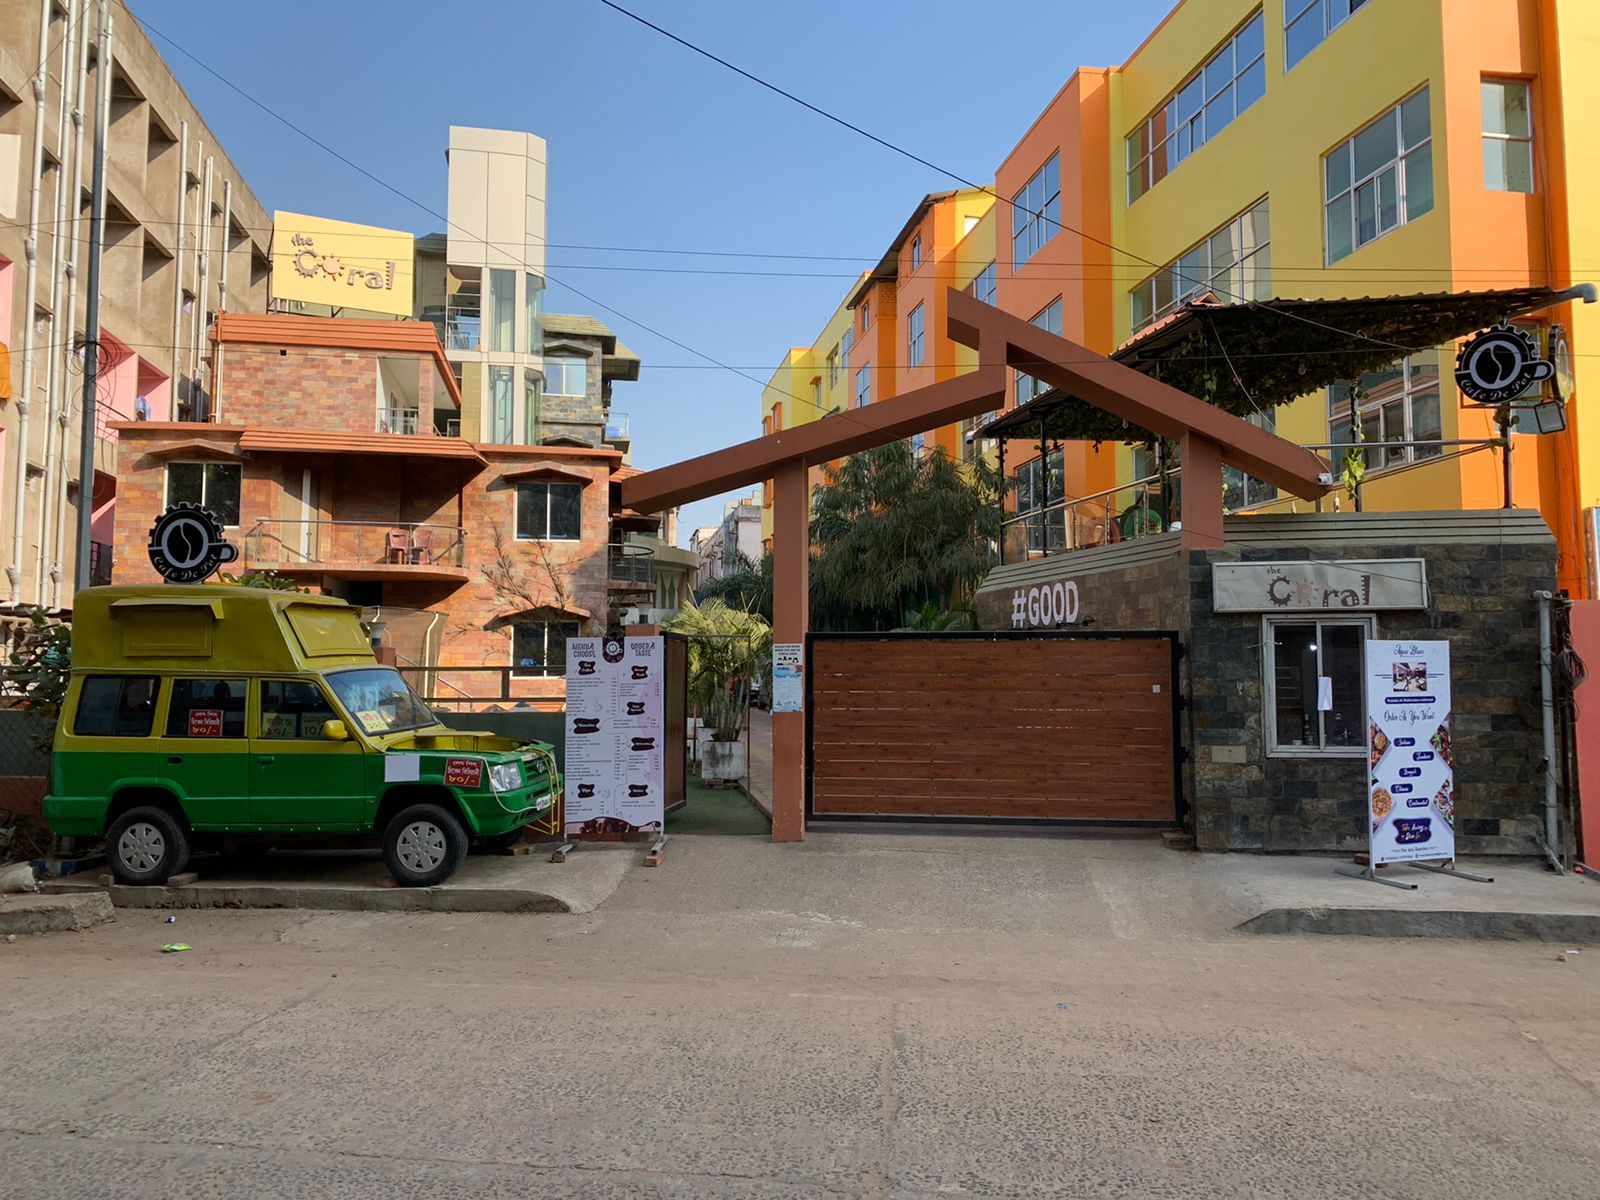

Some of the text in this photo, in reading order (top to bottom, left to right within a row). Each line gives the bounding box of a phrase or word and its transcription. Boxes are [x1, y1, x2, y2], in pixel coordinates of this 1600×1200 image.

[291, 233, 314, 247] the
[1460, 372, 1531, 400] Cafe De Pot
[153, 556, 178, 578] Cafe
[181, 571, 198, 580] De
[1266, 566, 1282, 575] the
[1011, 580, 1079, 629] #GOOD
[573, 650, 596, 658] CHOOSE
